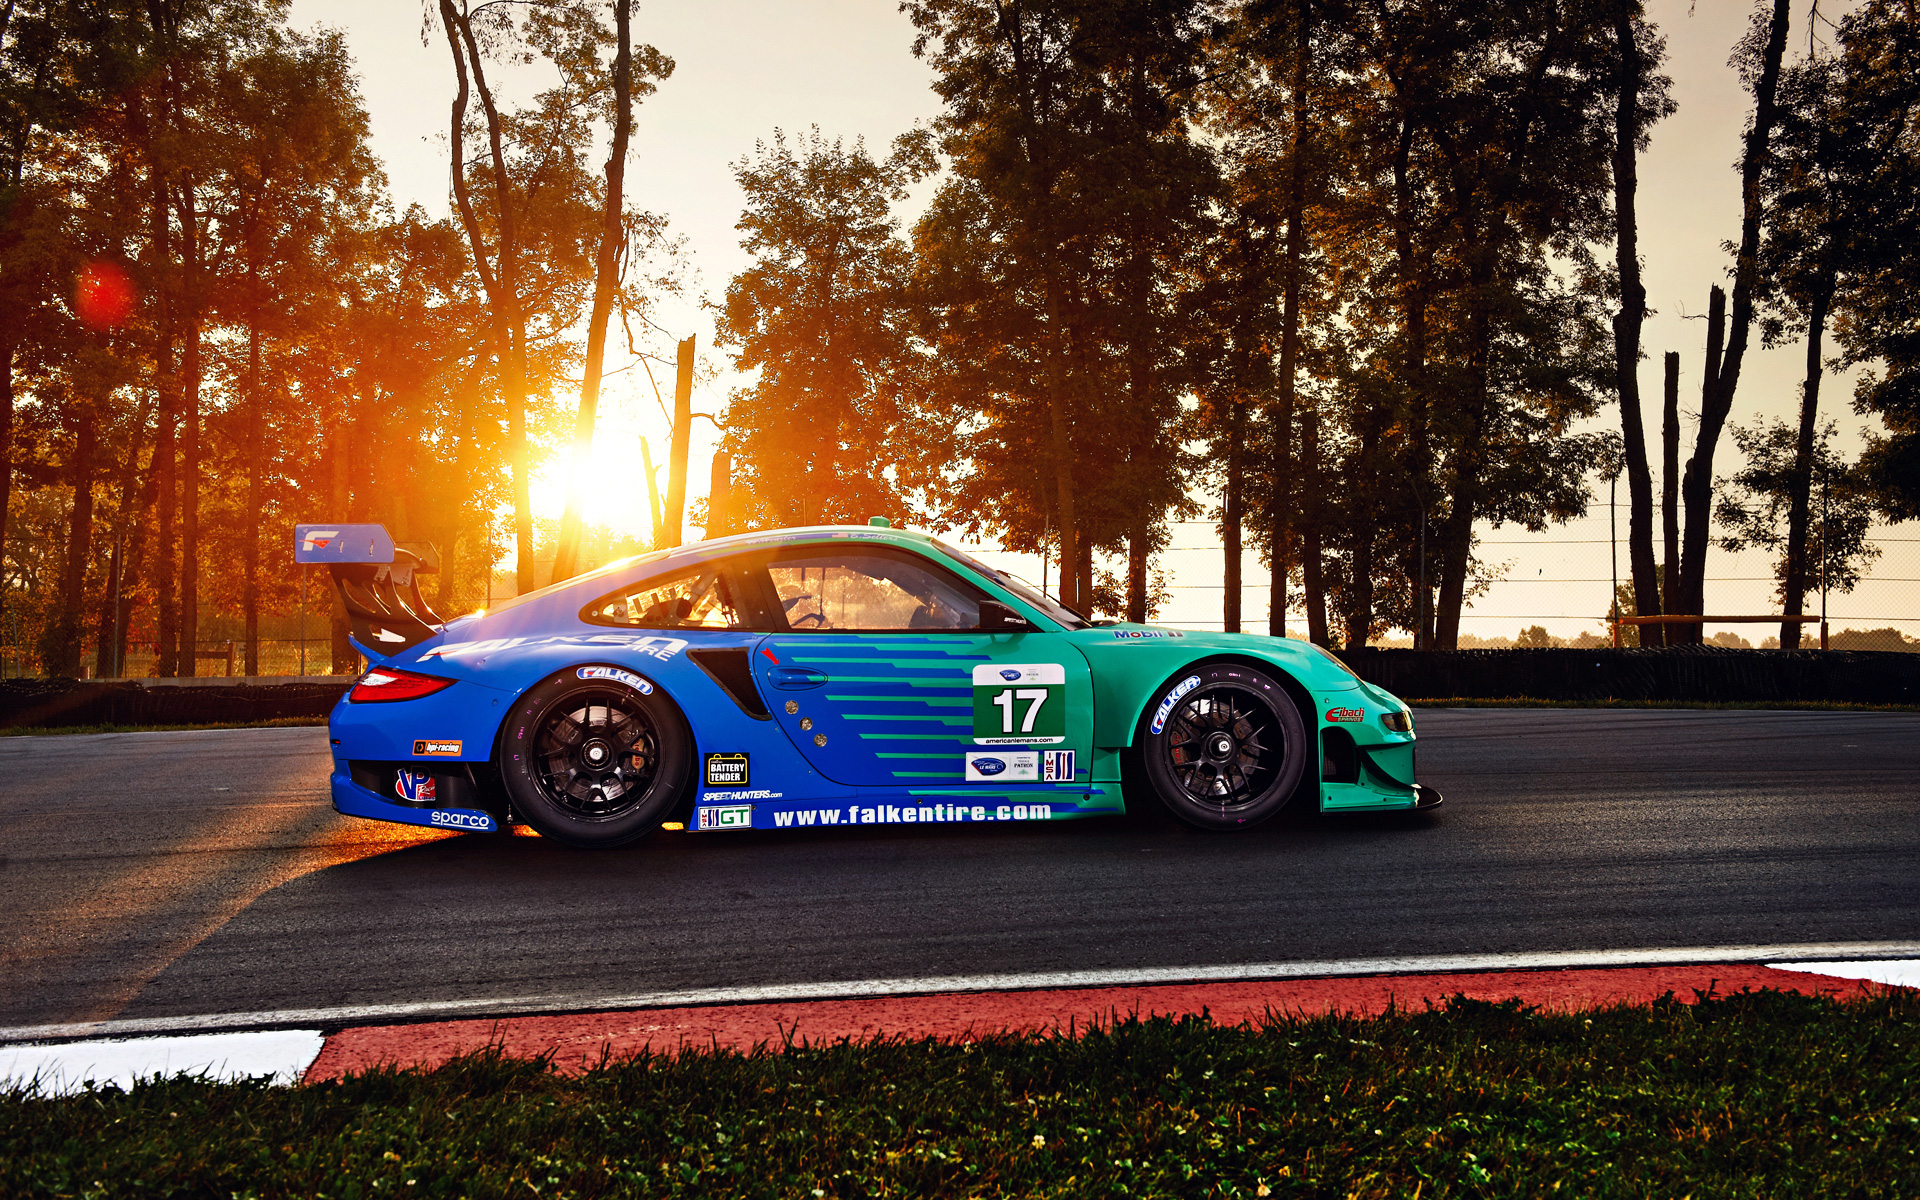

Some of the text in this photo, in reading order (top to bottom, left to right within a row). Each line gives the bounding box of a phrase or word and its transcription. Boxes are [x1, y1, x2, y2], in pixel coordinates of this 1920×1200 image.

[1113, 630, 1163, 638] Mobil
[416, 634, 689, 663] FALKEN
[583, 667, 651, 694] FALKEN
[1153, 676, 1199, 729] FALKEN
[993, 688, 1048, 734] 17
[1325, 707, 1365, 722] Eibach
[426, 742, 460, 753] hpi-racing
[710, 763, 745, 773] BATTERY
[397, 766, 431, 800] VP
[710, 772, 741, 782] TENDER
[702, 790, 783, 801] SPEEDHUNTERS.com
[431, 811, 489, 827] sparco
[720, 809, 749, 825] GT
[773, 804, 1052, 827] www.falkentire.com
